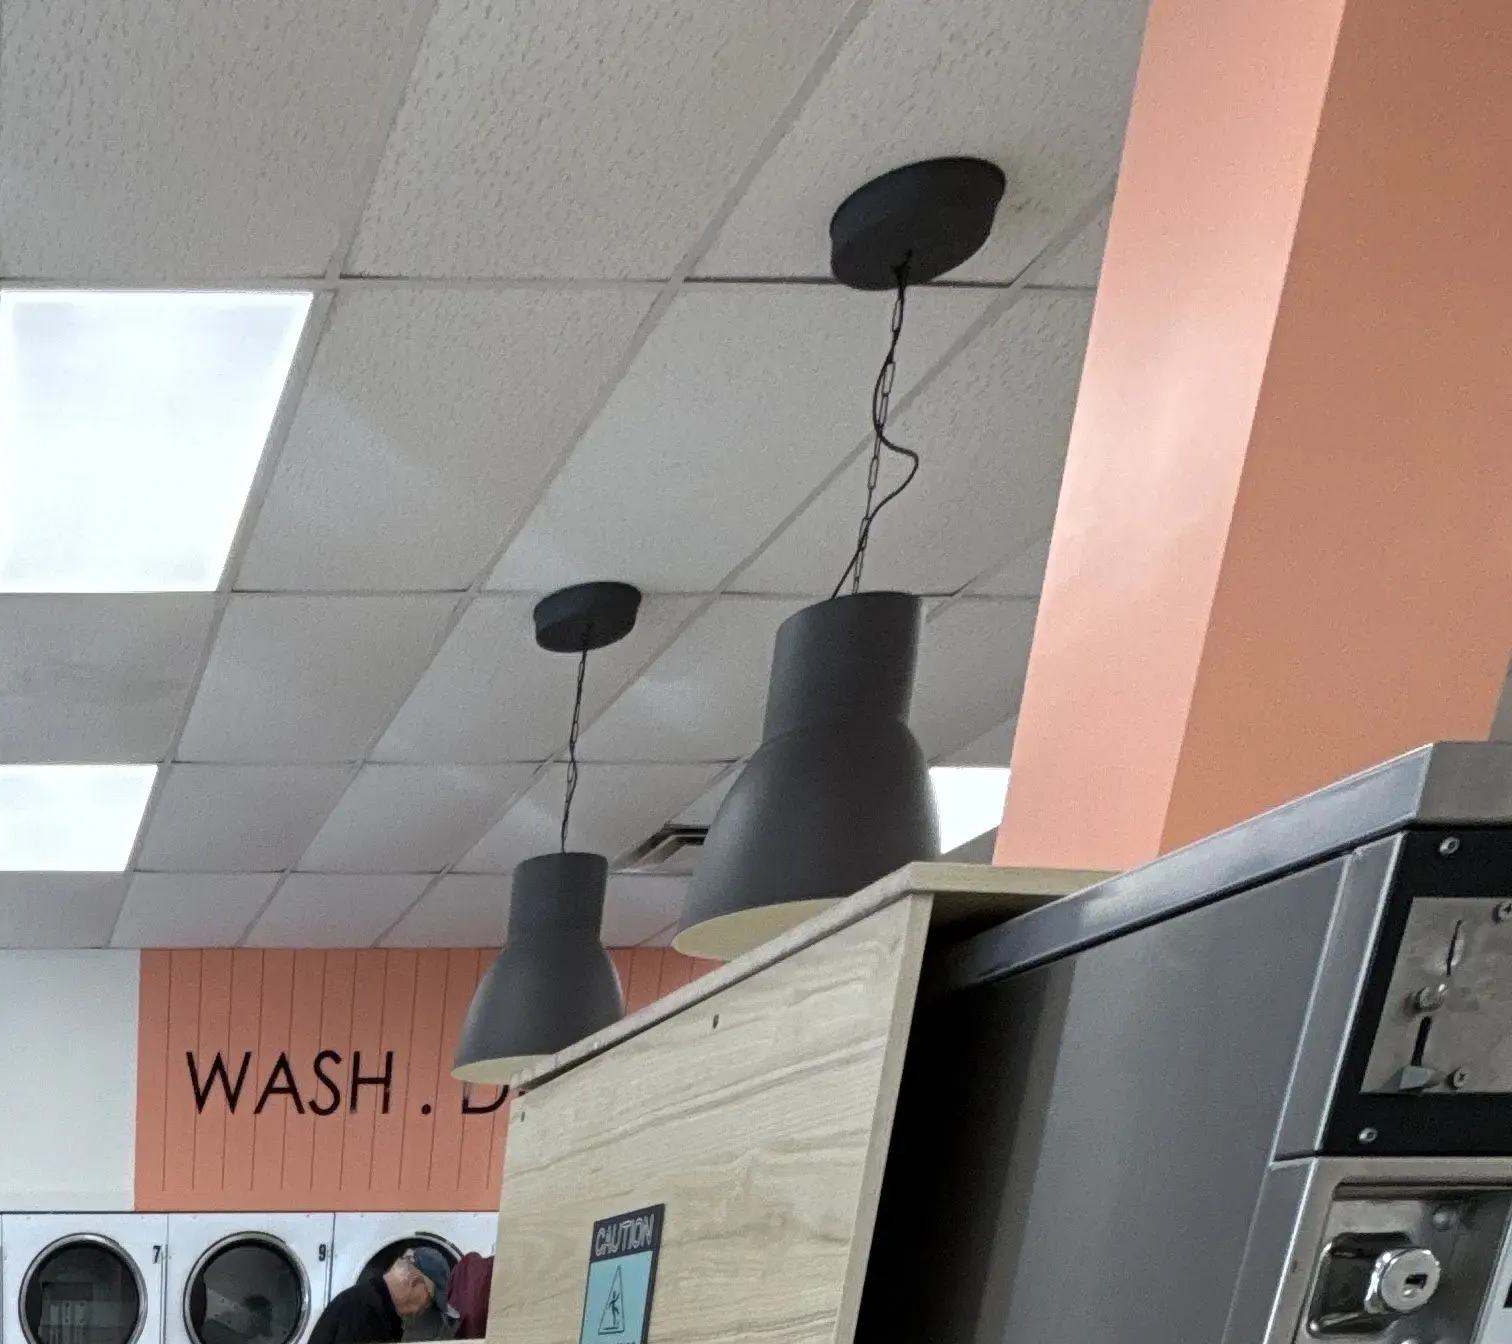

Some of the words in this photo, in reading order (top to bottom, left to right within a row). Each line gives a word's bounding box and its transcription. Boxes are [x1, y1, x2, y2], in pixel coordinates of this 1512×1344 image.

[185, 1049, 394, 1116] WASH
[595, 1213, 655, 1257] CAUTION
[152, 1245, 161, 1264] 7
[318, 1243, 326, 1262] 9
